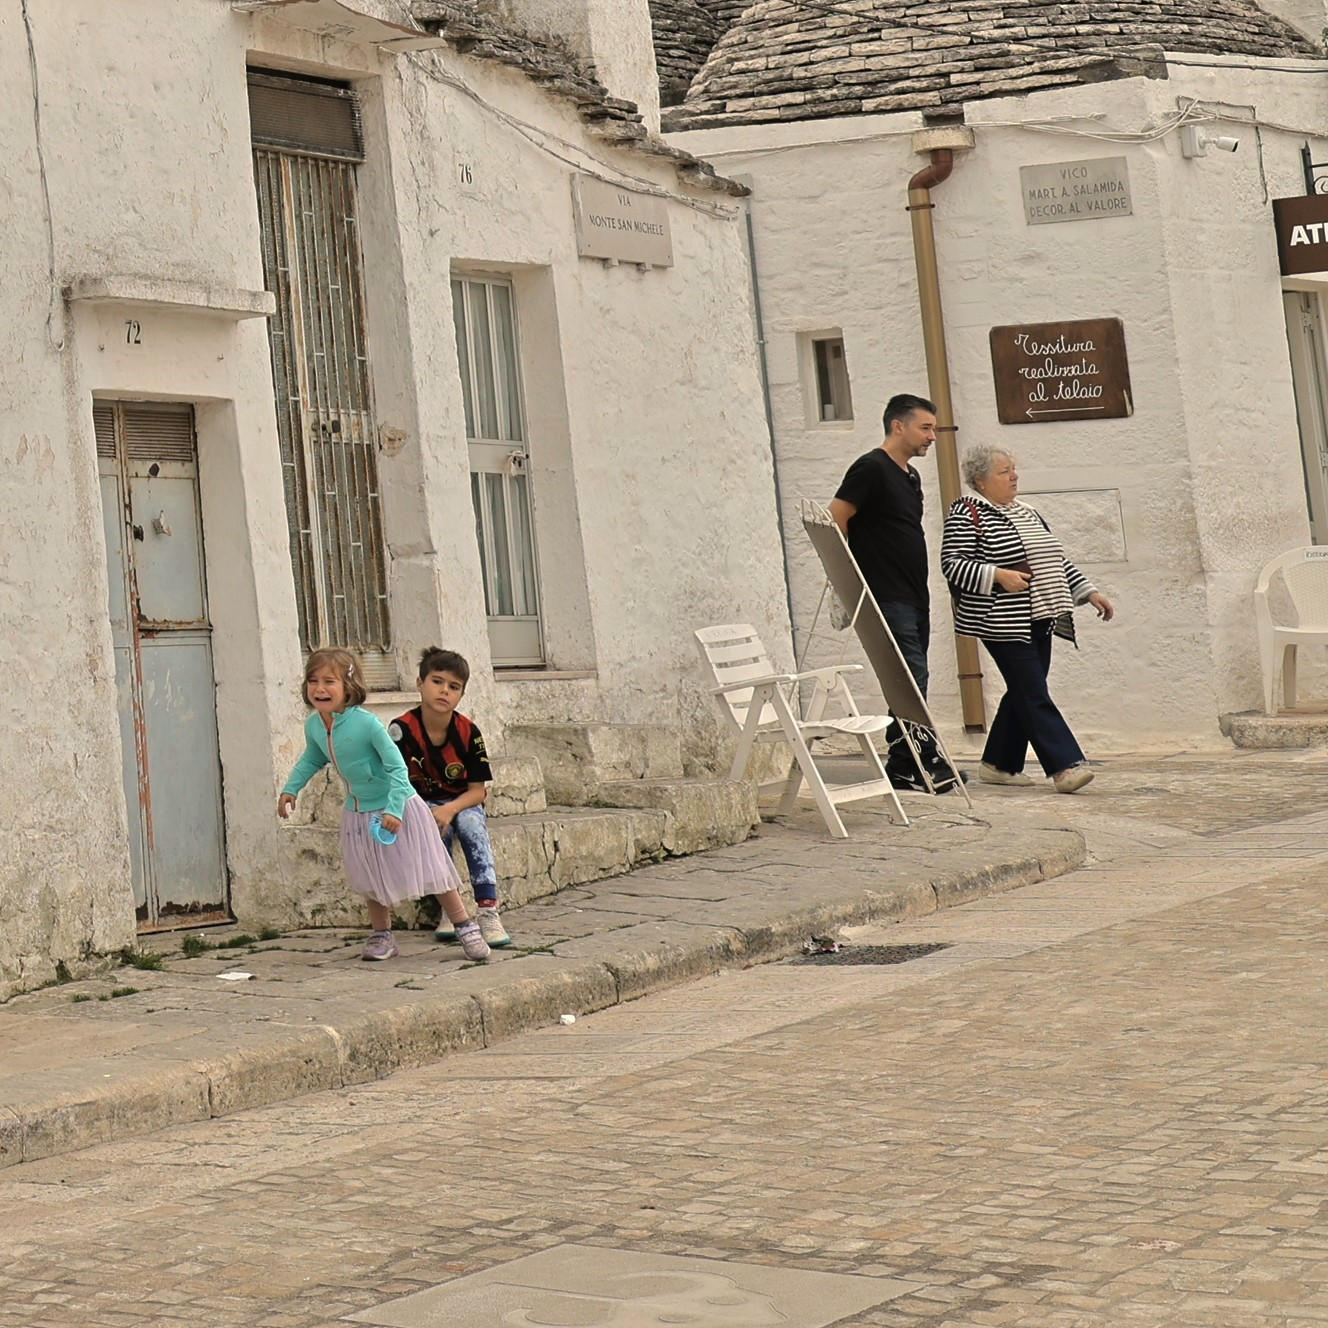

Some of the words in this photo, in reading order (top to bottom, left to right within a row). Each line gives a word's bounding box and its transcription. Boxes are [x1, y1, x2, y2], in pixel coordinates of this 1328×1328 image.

[457, 163, 472, 185] 76
[1059, 167, 1088, 180] VICO
[1072, 180, 1124, 195] SALAMIDA
[617, 194, 632, 207] VIA
[1069, 202, 1081, 214] AL
[1086, 197, 1127, 211] VALORE
[618, 219, 633, 231] SAN
[634, 221, 664, 236] MICHELE
[125, 319, 141, 345] 72
[1014, 333, 1096, 356] Tessitura
[1018, 358, 1100, 379] realizzata
[1028, 382, 1049, 403] al
[1053, 379, 1103, 401] telaio
